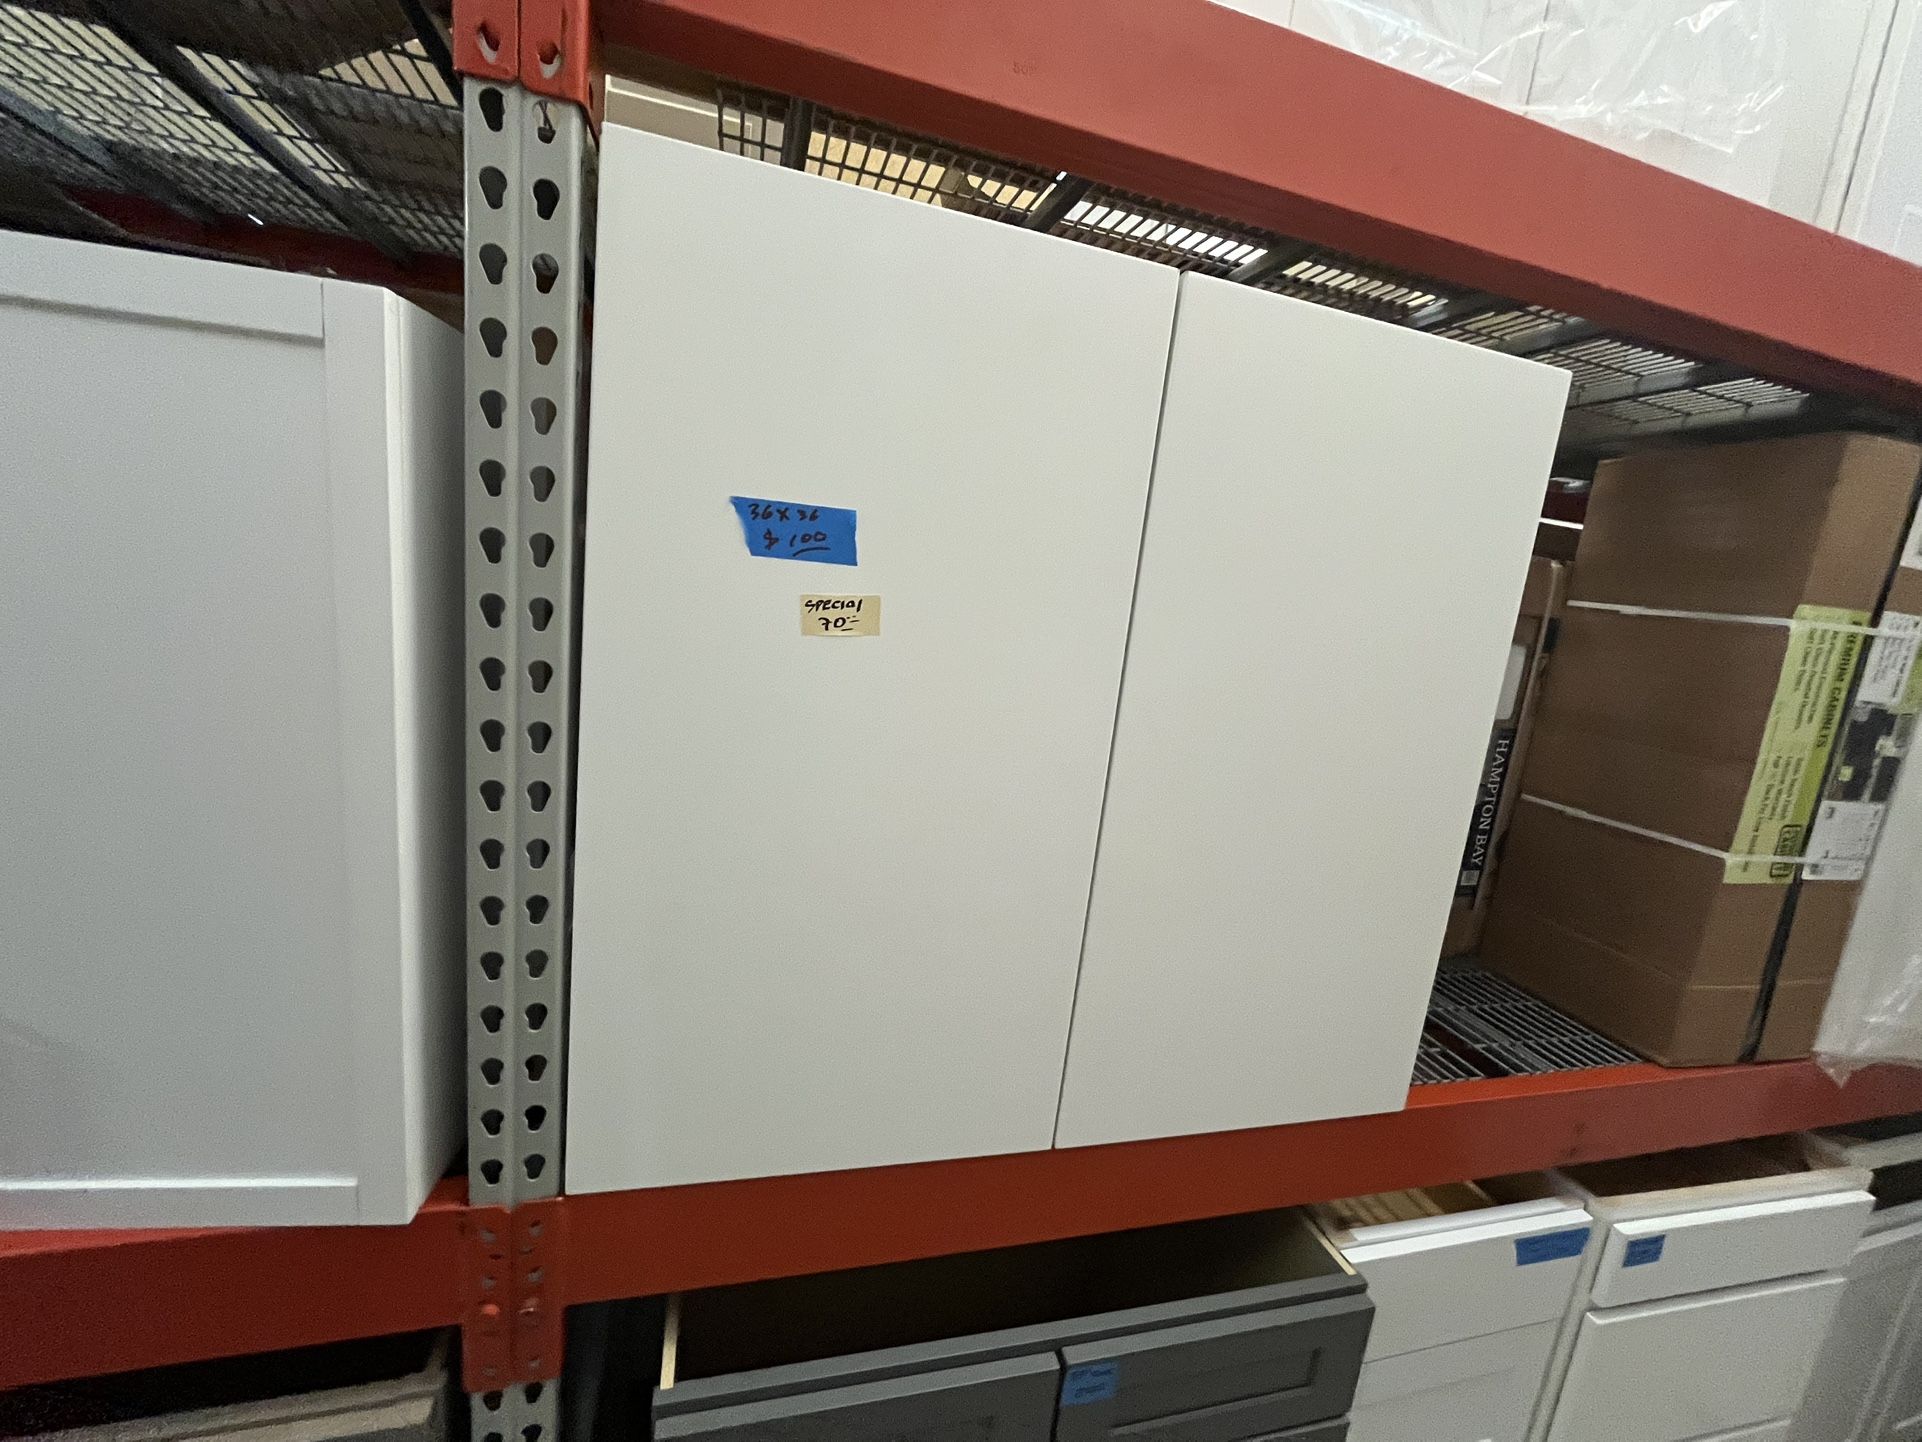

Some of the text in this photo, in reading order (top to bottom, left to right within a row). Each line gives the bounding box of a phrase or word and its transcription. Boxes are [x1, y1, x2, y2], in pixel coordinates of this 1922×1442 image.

[1815, 686, 1843, 748] CABINETS
[1471, 739, 1510, 867] HAMPTON BAY
